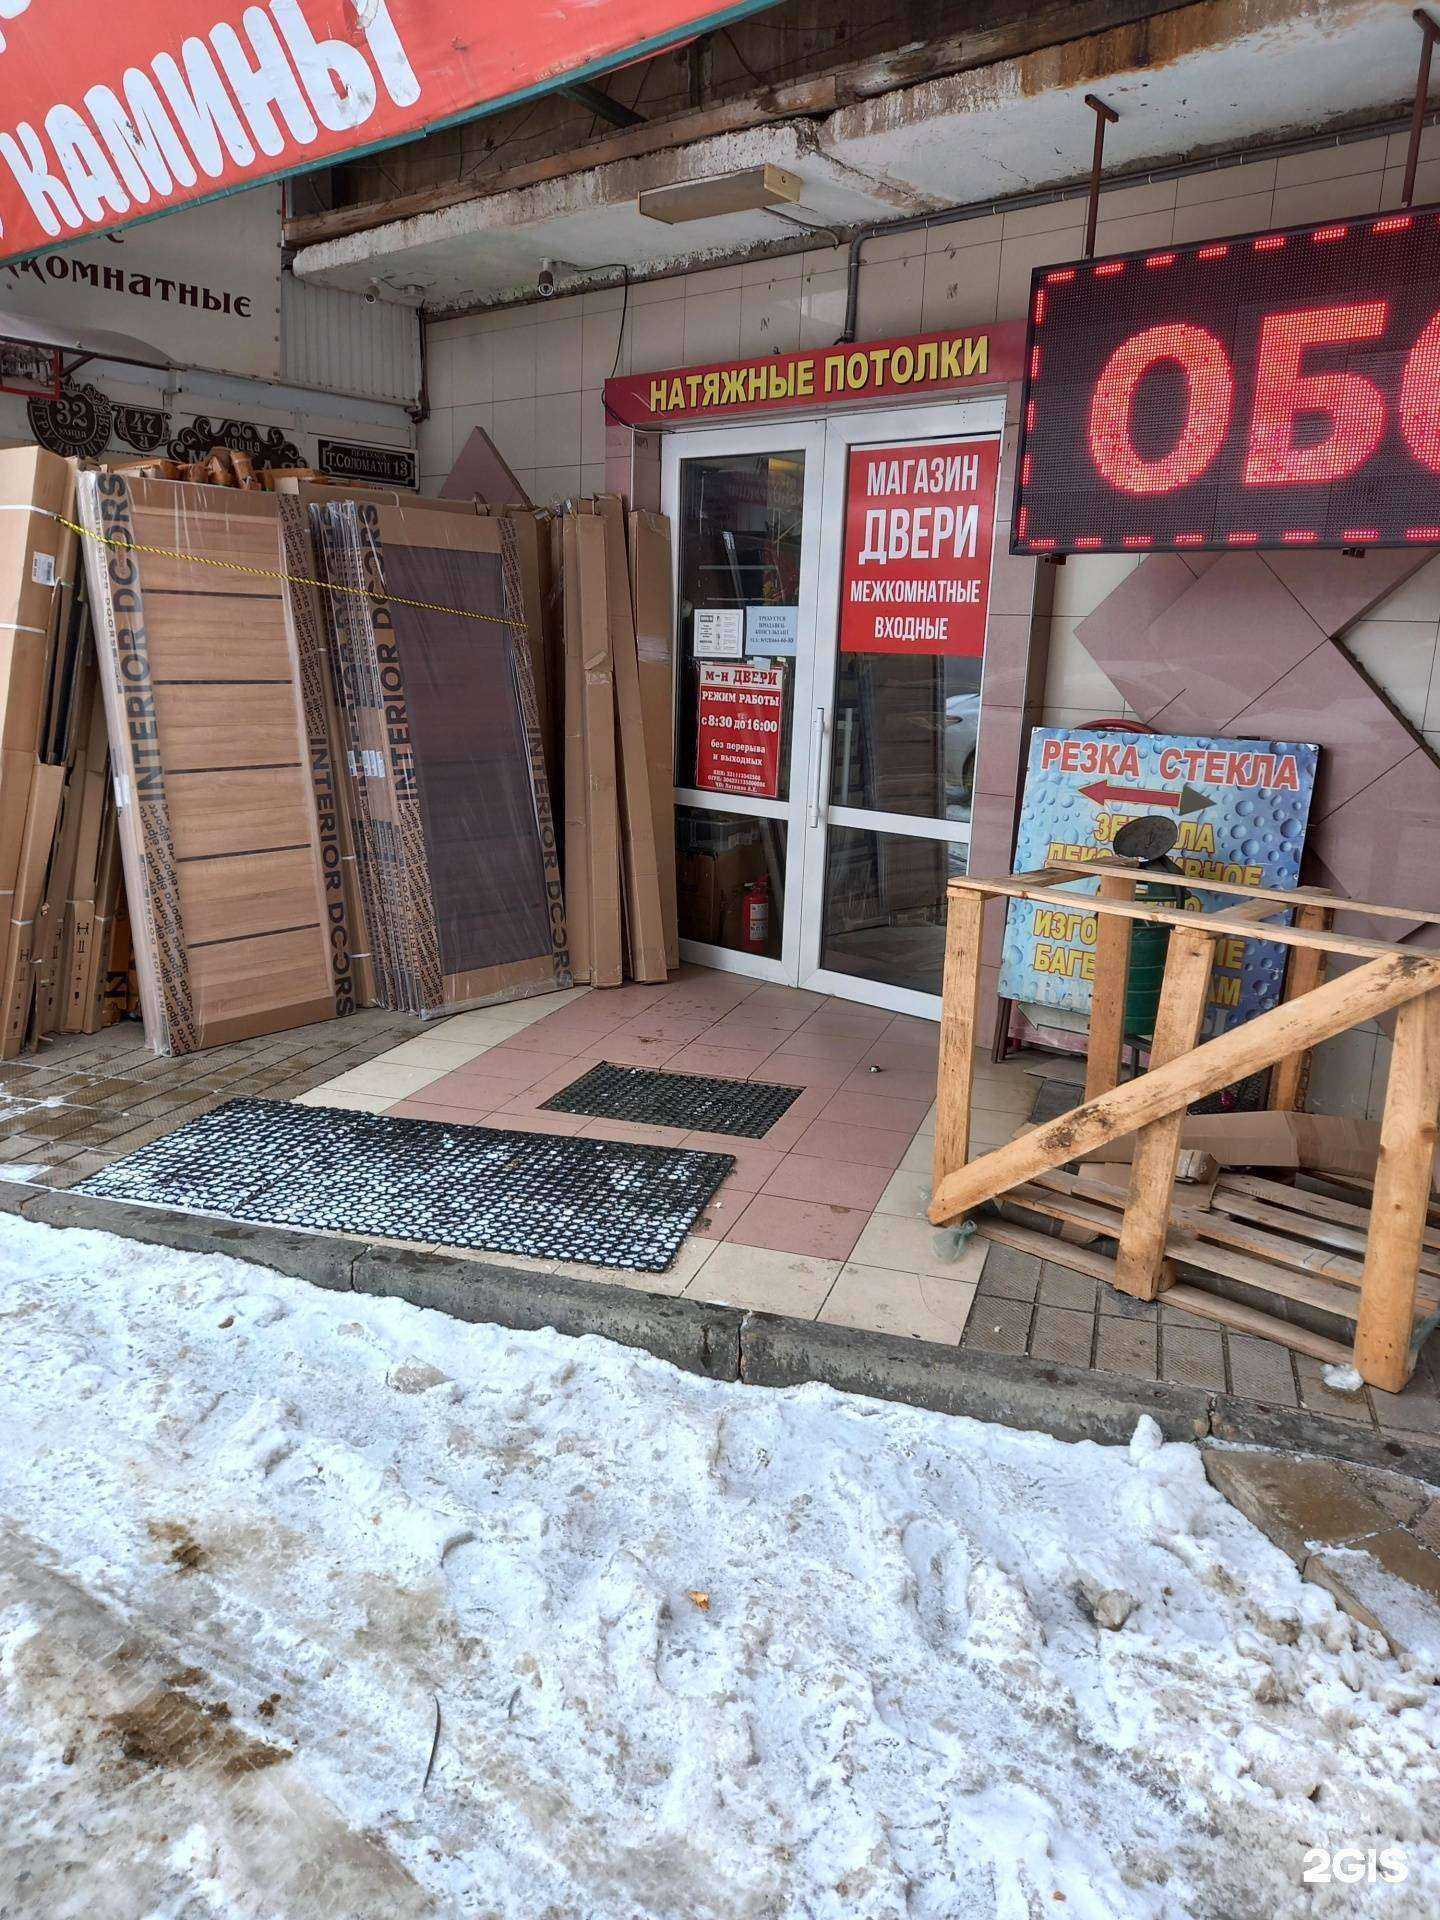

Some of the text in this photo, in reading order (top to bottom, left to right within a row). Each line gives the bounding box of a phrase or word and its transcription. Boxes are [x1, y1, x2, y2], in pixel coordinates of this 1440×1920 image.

[0, 0, 422, 237] КАМИНЫ
[649, 334, 989, 413] НАТЯЖНЫЕ ПОТОЛКИ
[866, 454, 980, 497] МАГАЗИН
[857, 504, 980, 566] ДВЕРИ
[849, 579, 982, 604] МЕЖКОМНАТНЫЕ
[873, 615, 949, 641] ВХОДНЫЕ
[702, 690, 780, 706] РЕЖИМ РАБОТЫ
[733, 669, 778, 685] ДВЕРИ
[117, 628, 166, 801] INTERIOR
[374, 640, 419, 801] INTERIOR
[747, 718, 778, 733] 16:00
[710, 738, 766, 754] без перерыва
[720, 754, 763, 766] выходных
[1041, 740, 1301, 791] РЕЗКА СТЕКЛА
[310, 738, 343, 891] INTERIOR
[528, 727, 558, 869] INTERIOR
